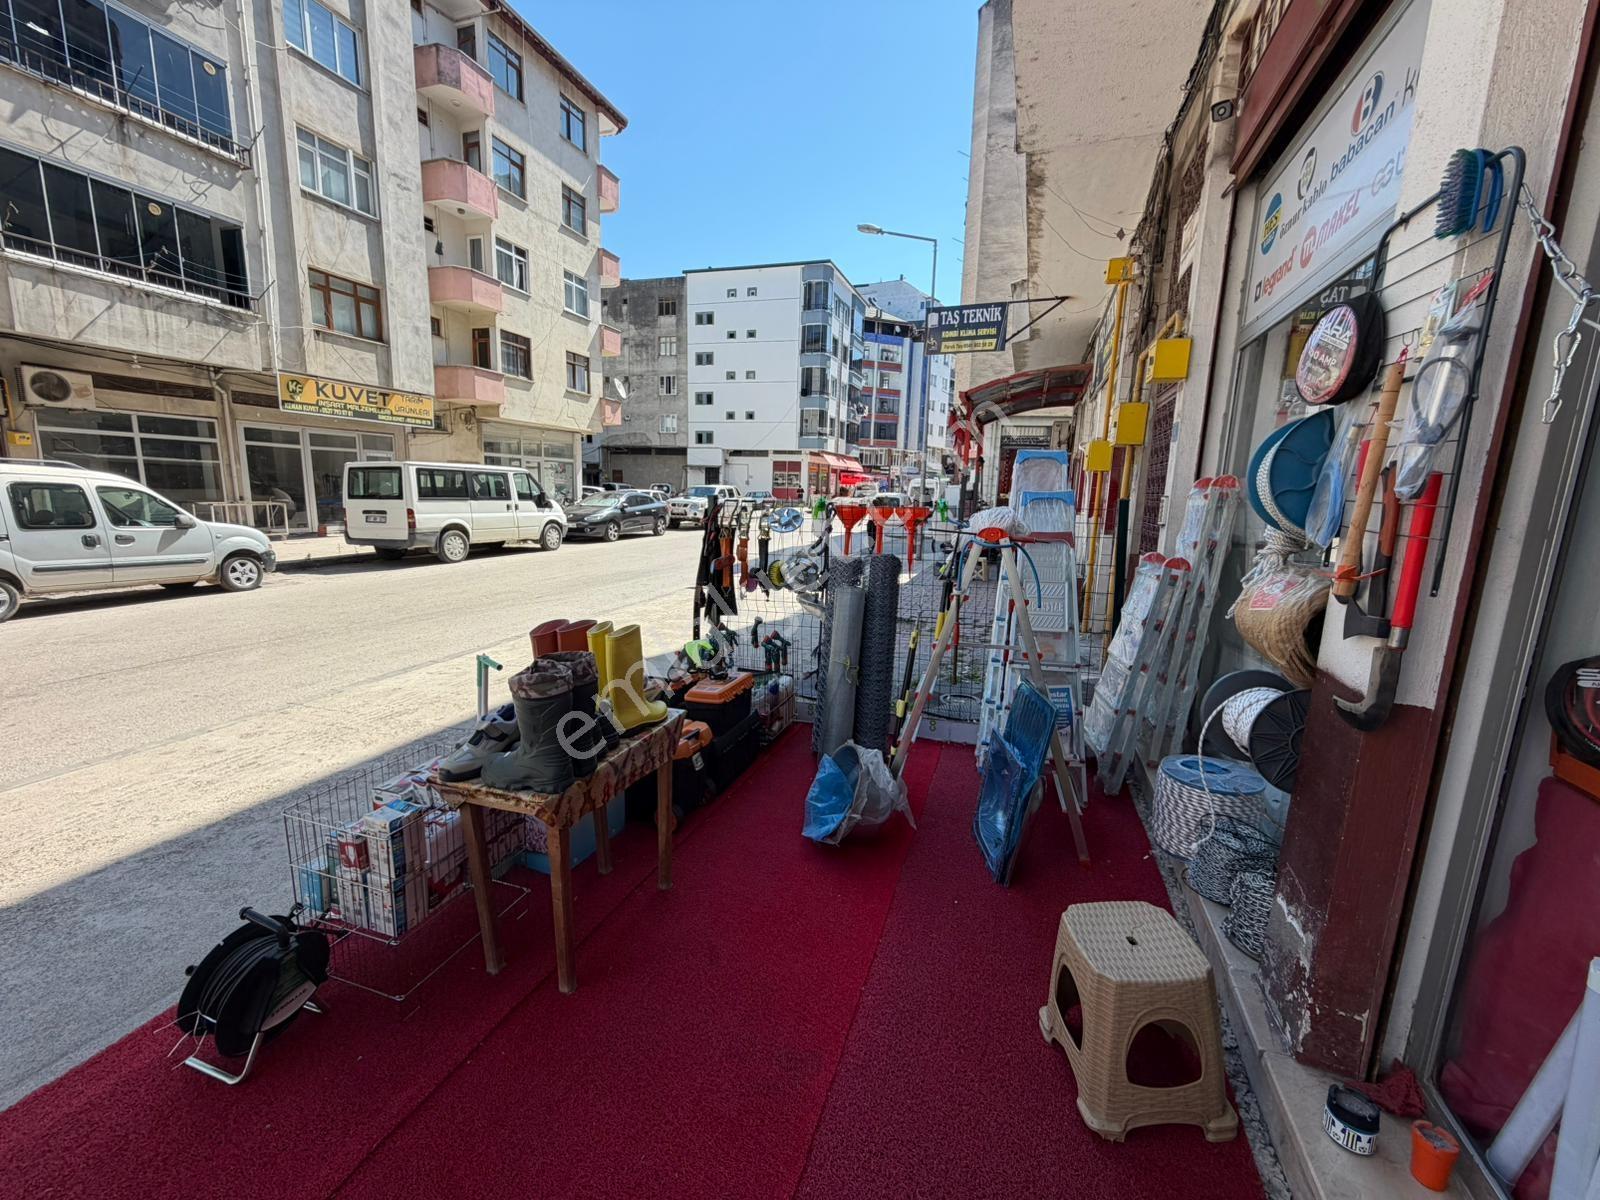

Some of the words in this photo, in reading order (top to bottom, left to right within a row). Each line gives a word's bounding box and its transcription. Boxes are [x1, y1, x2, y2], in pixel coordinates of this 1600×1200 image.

[1330, 100, 1395, 183] babacan
[1261, 248, 1296, 297] legrand
[940, 310, 960, 328] TAŞ
[962, 305, 1002, 323] TEKNİK
[315, 381, 389, 407] KUVET
